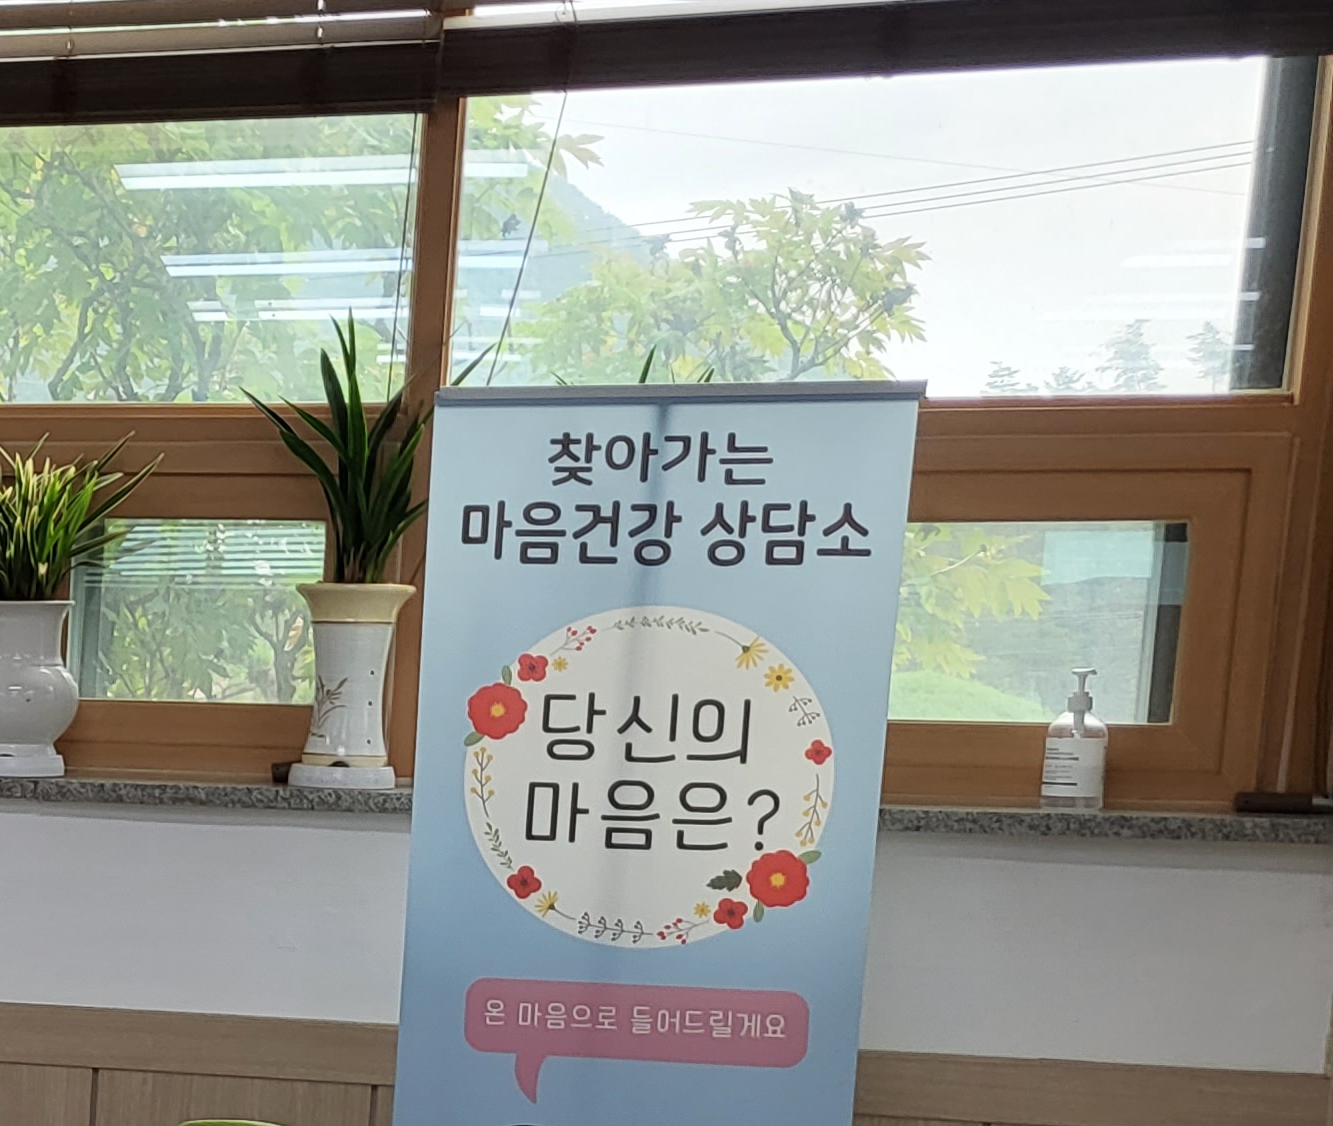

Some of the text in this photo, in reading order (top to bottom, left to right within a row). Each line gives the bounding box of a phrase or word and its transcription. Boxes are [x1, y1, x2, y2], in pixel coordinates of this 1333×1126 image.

[548, 431, 774, 487] 찾아가는
[460, 500, 872, 567] 마음건강 상담소
[541, 692, 752, 766] 당신의
[525, 780, 781, 851] 마음은?
[483, 999, 787, 1040] 온 마음으로 들어드릴게요
